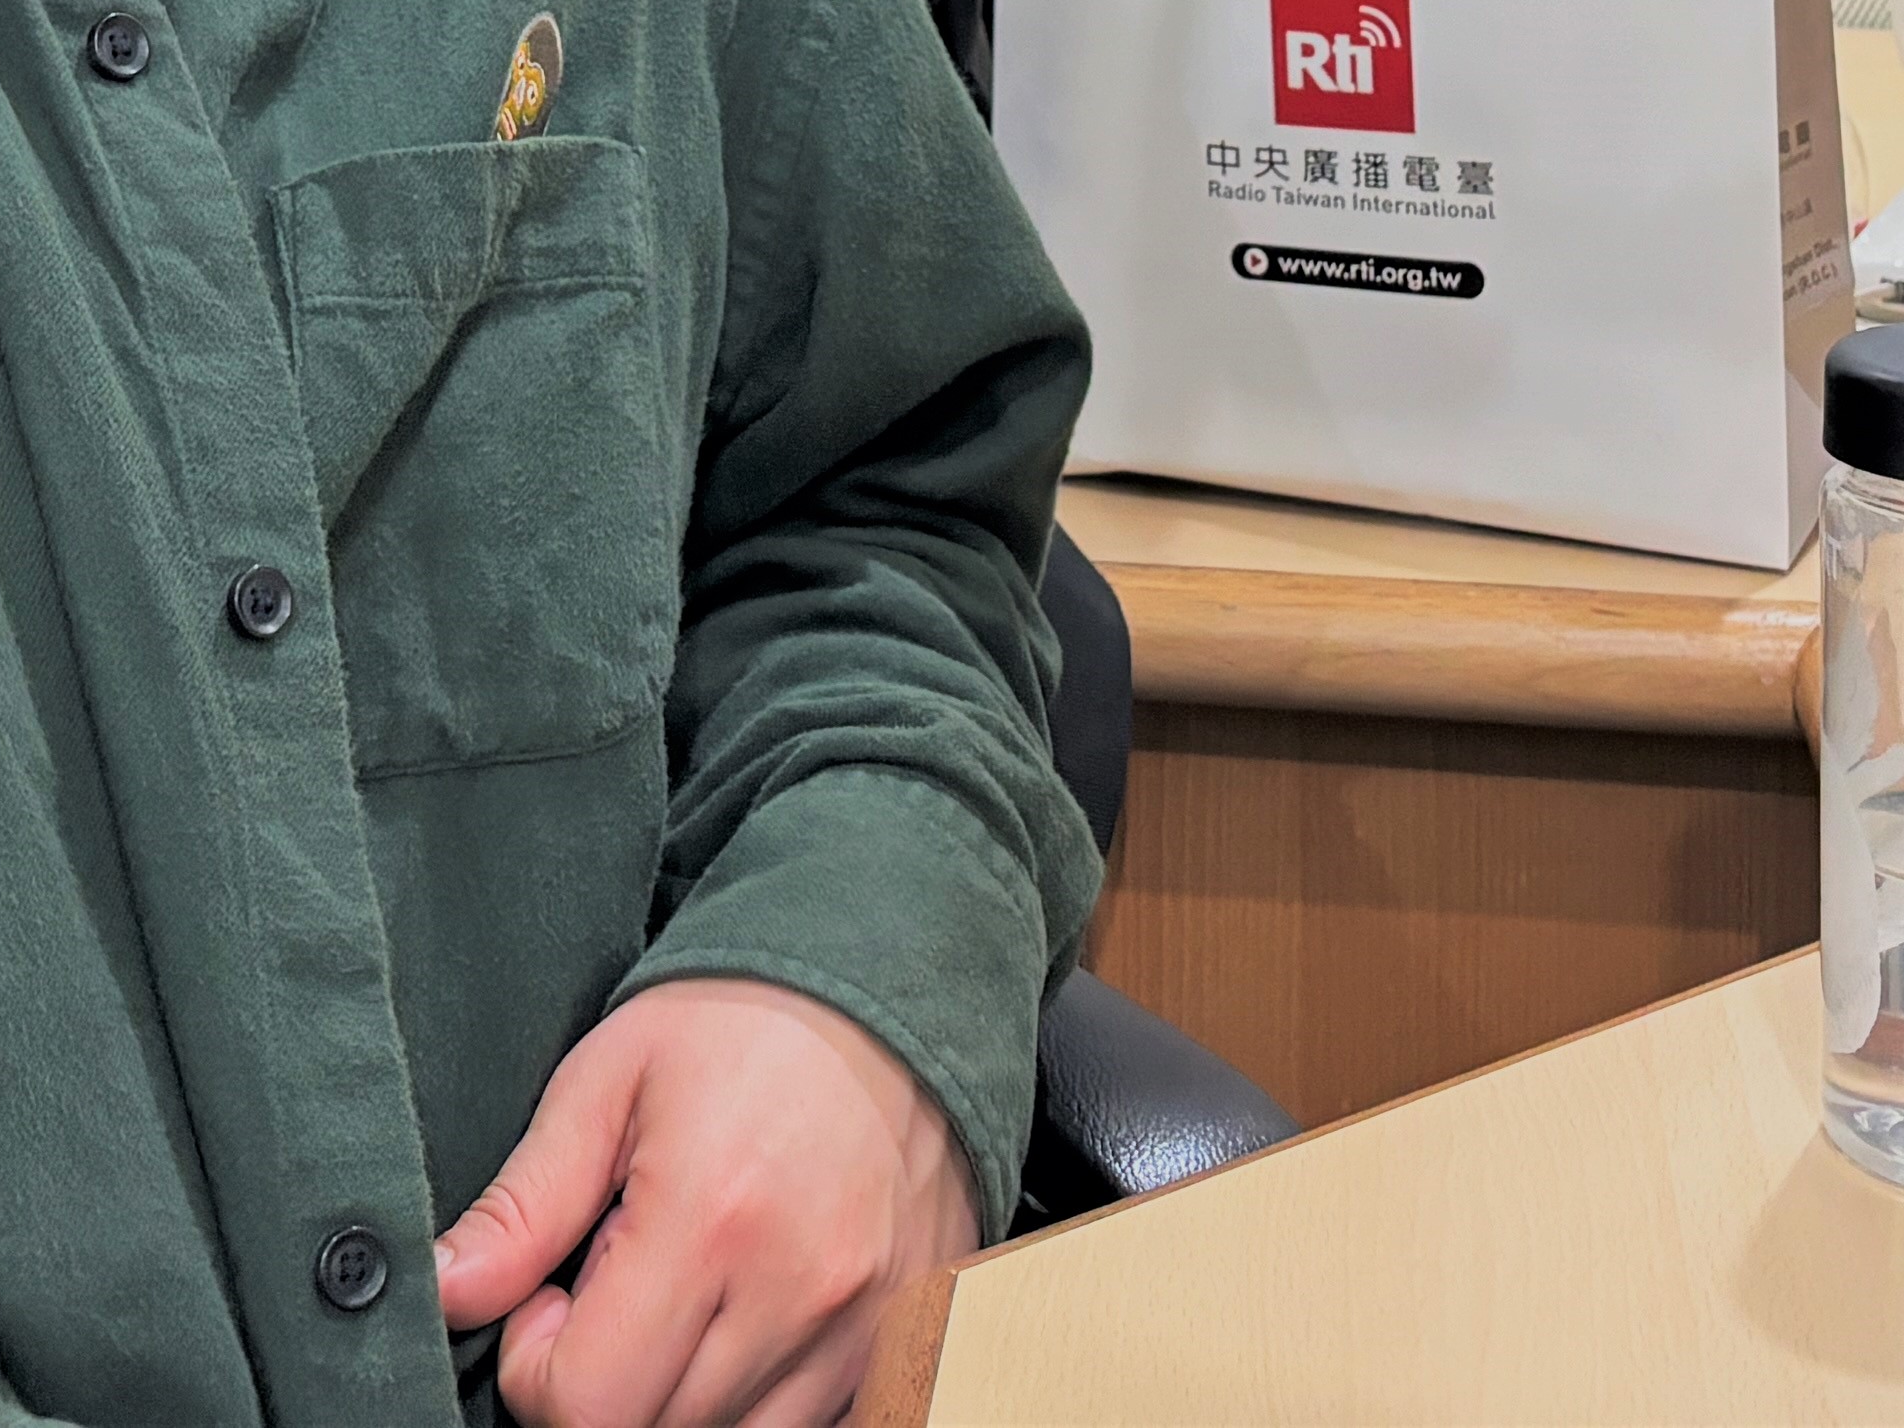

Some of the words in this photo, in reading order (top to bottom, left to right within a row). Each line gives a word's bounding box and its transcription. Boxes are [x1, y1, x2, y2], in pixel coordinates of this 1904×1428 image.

[1285, 29, 1375, 96] Rti
[1205, 139, 1495, 196] 中央廣播電臺
[1207, 179, 1267, 204] Radio
[1272, 184, 1347, 210] Taiwan
[1352, 192, 1497, 221] International
[1277, 253, 1463, 293] www.rti.org.tw
